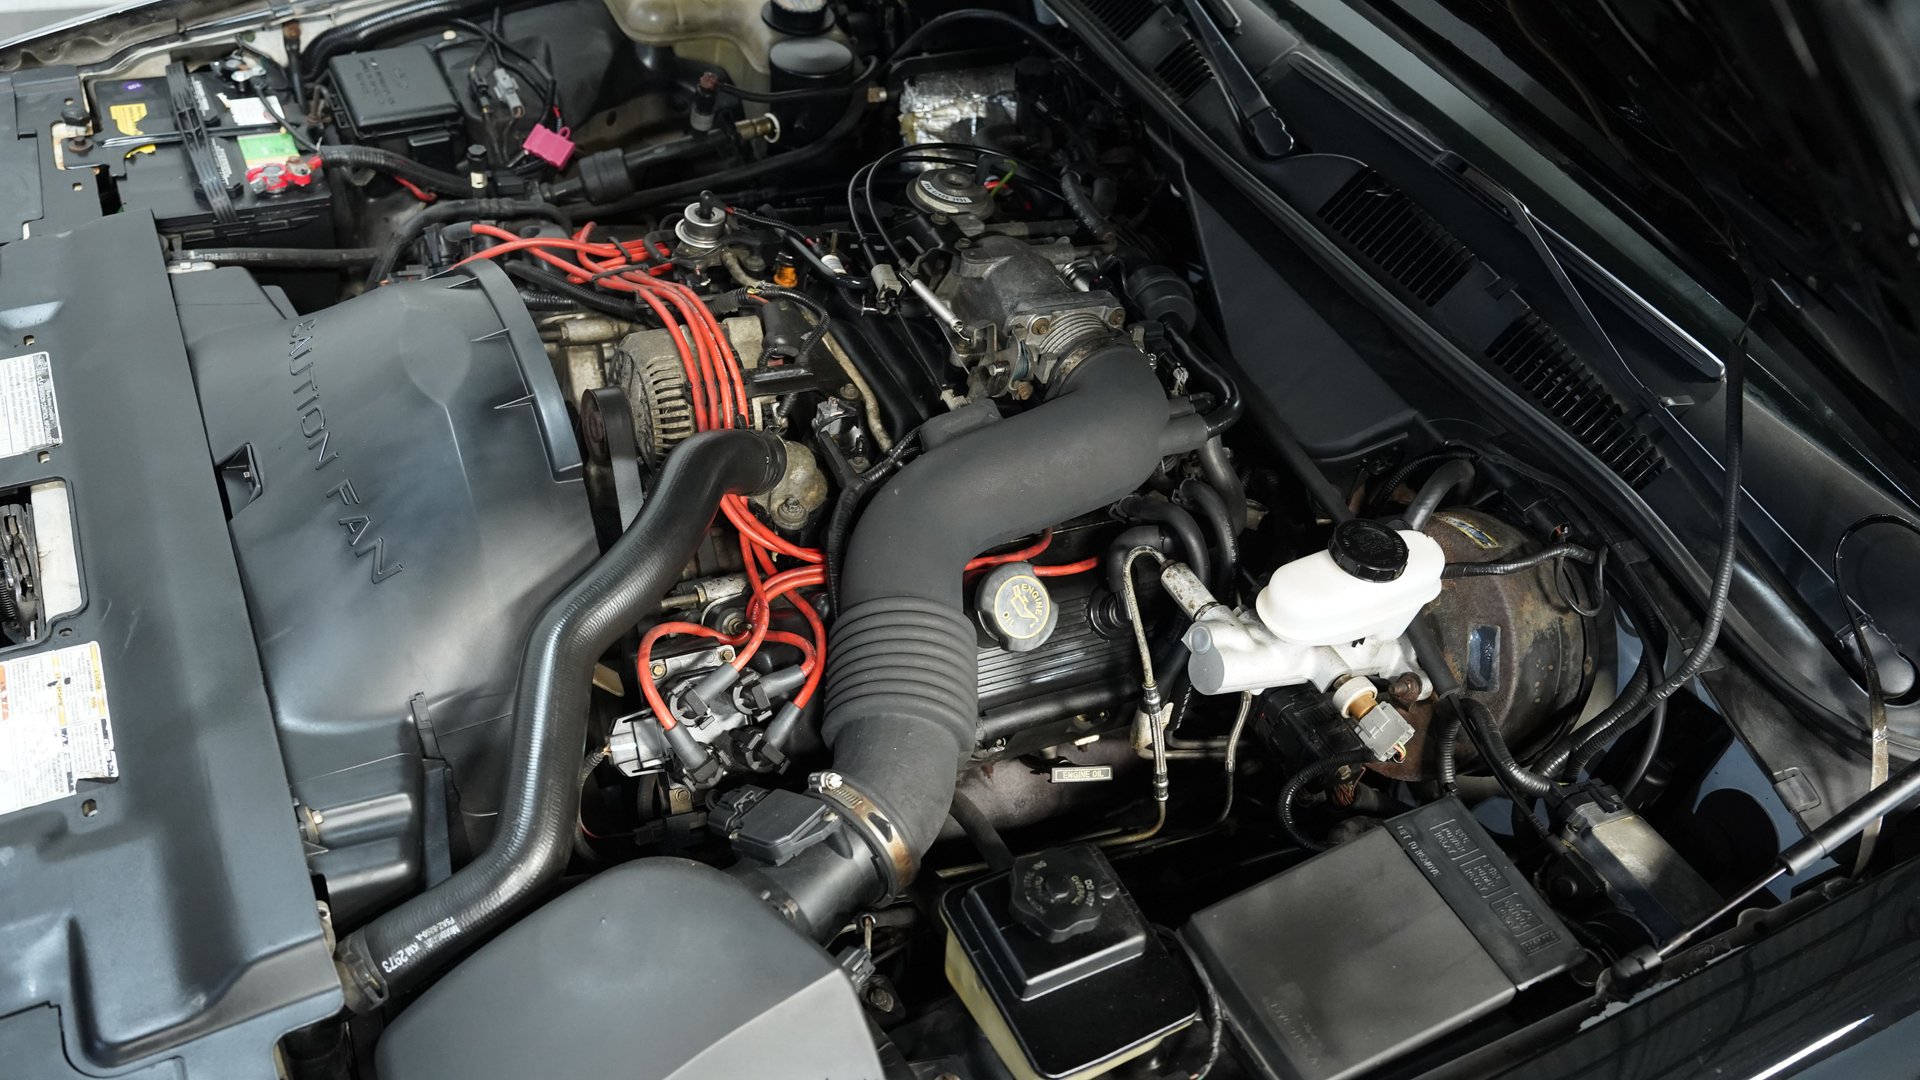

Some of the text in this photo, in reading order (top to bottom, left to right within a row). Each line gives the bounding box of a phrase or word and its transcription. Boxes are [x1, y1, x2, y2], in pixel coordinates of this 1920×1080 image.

[289, 317, 404, 584] CAUTION FAN
[1003, 584, 1043, 627] ENGINE OIL
[1062, 769, 1104, 779] ENGINE OIL
[1084, 879, 1095, 890] DO
[381, 942, 420, 973] KM 2973
